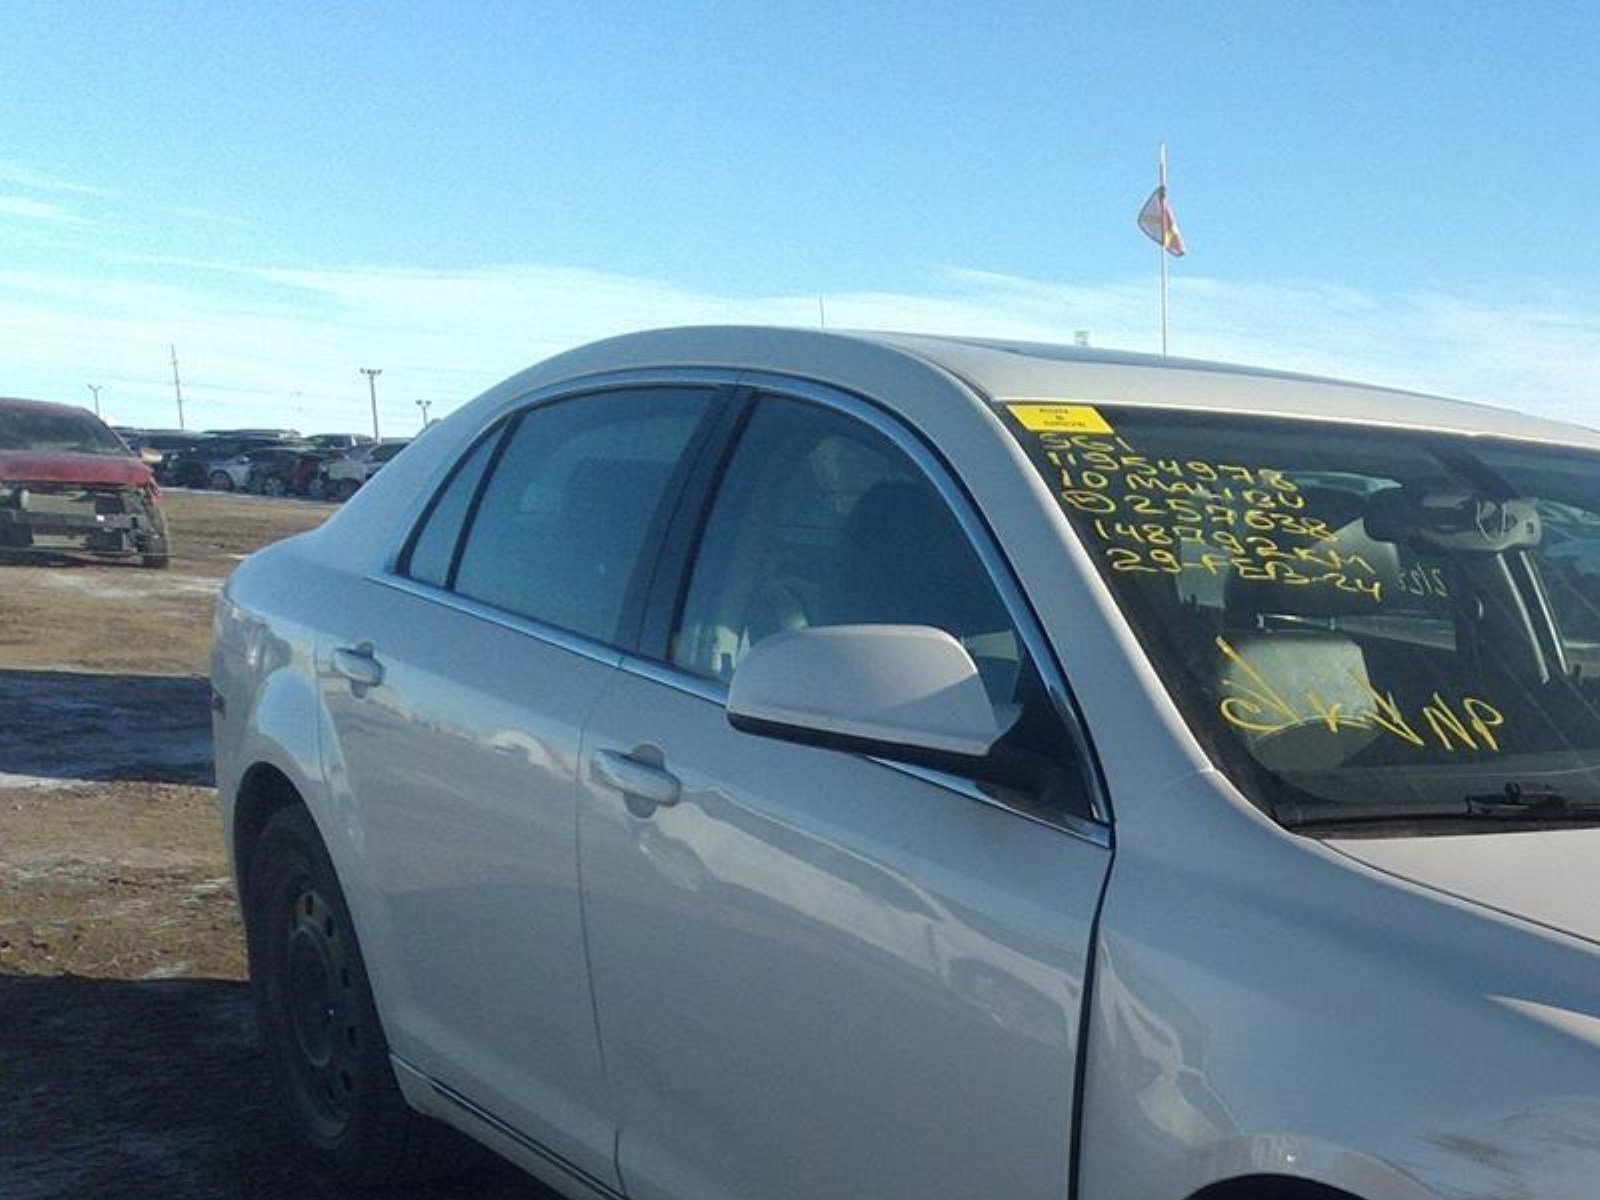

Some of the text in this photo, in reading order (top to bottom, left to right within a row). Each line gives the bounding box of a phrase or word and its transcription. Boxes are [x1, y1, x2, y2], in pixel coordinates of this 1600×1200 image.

[1046, 450, 1298, 493] 11954978
[1060, 467, 1109, 489] 10
[1123, 494, 1339, 543] 257638
